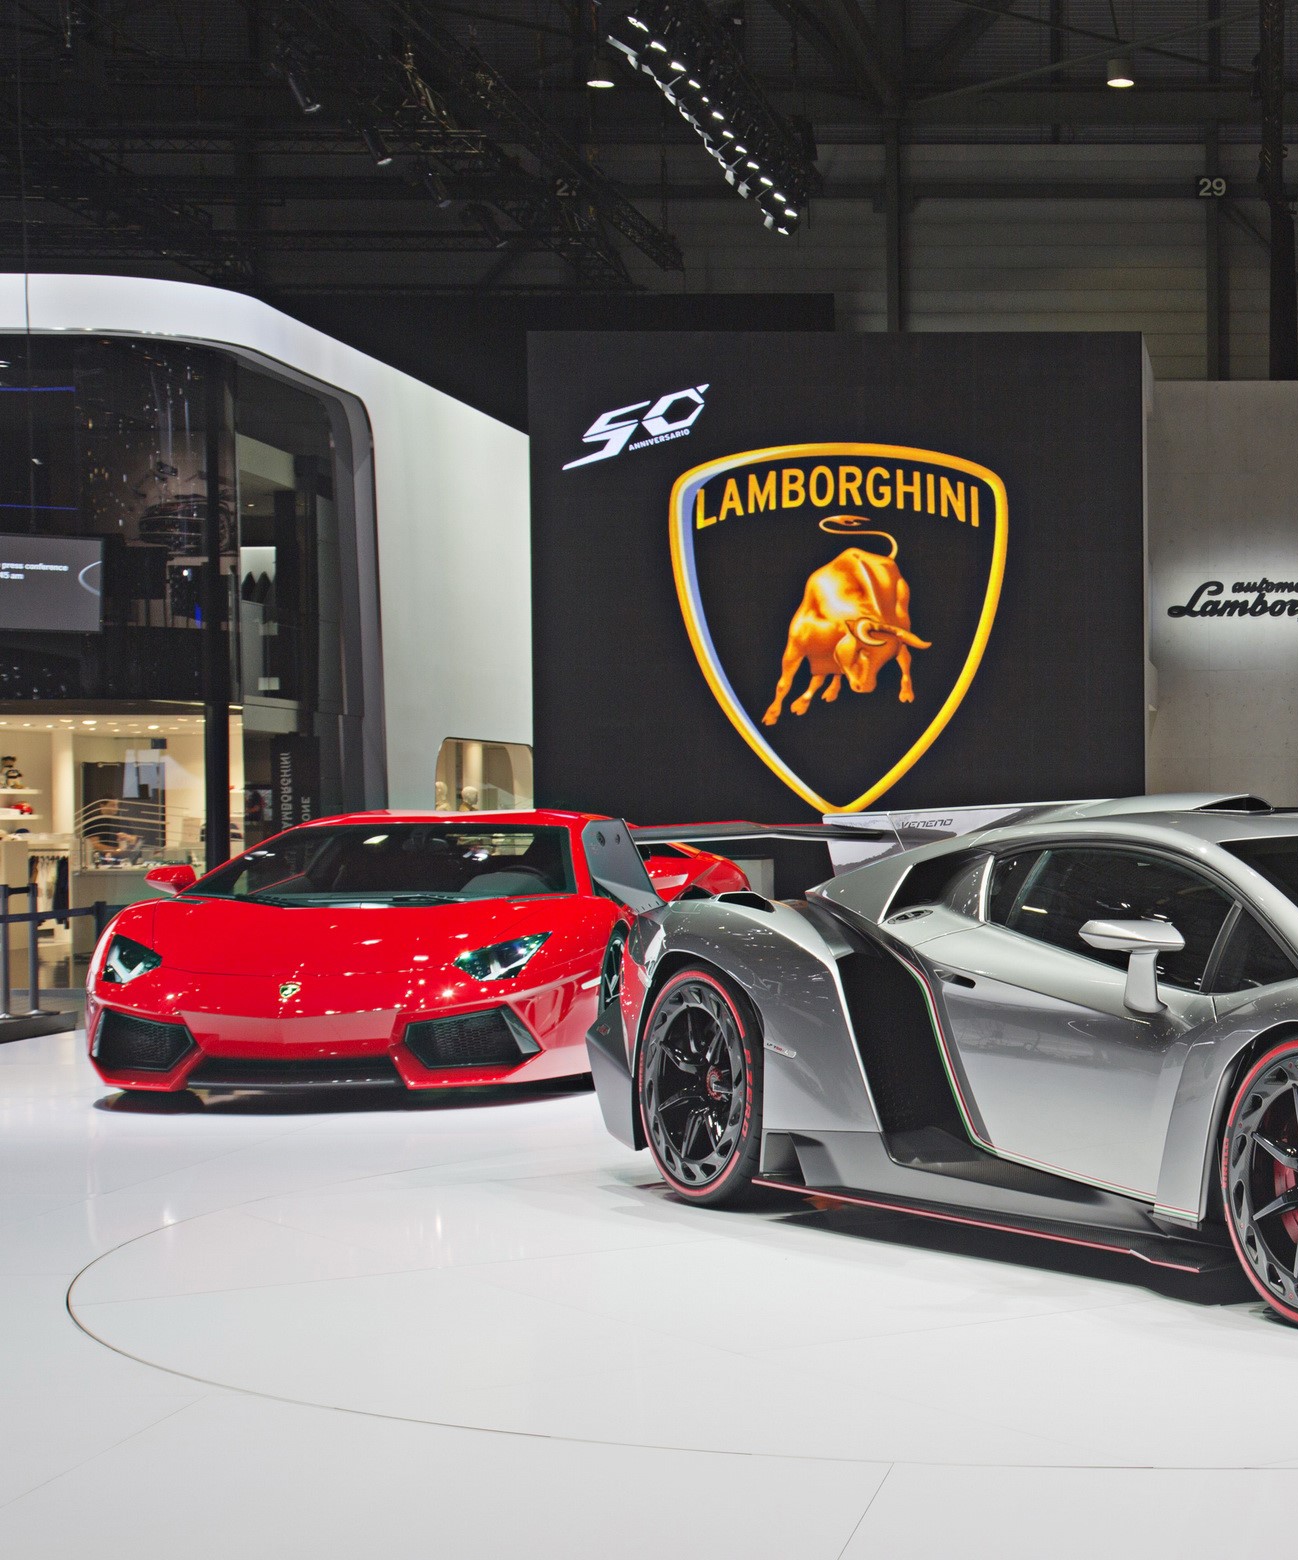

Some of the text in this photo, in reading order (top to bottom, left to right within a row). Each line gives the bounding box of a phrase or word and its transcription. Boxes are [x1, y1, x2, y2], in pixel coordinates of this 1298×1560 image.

[556, 178, 577, 197] 2
[1199, 178, 1226, 196] 29
[628, 428, 690, 451] ANNIVERSARIO
[696, 465, 980, 530] LAMBORGHINI
[24, 563, 69, 572] conference
[901, 818, 954, 829] VENENO
